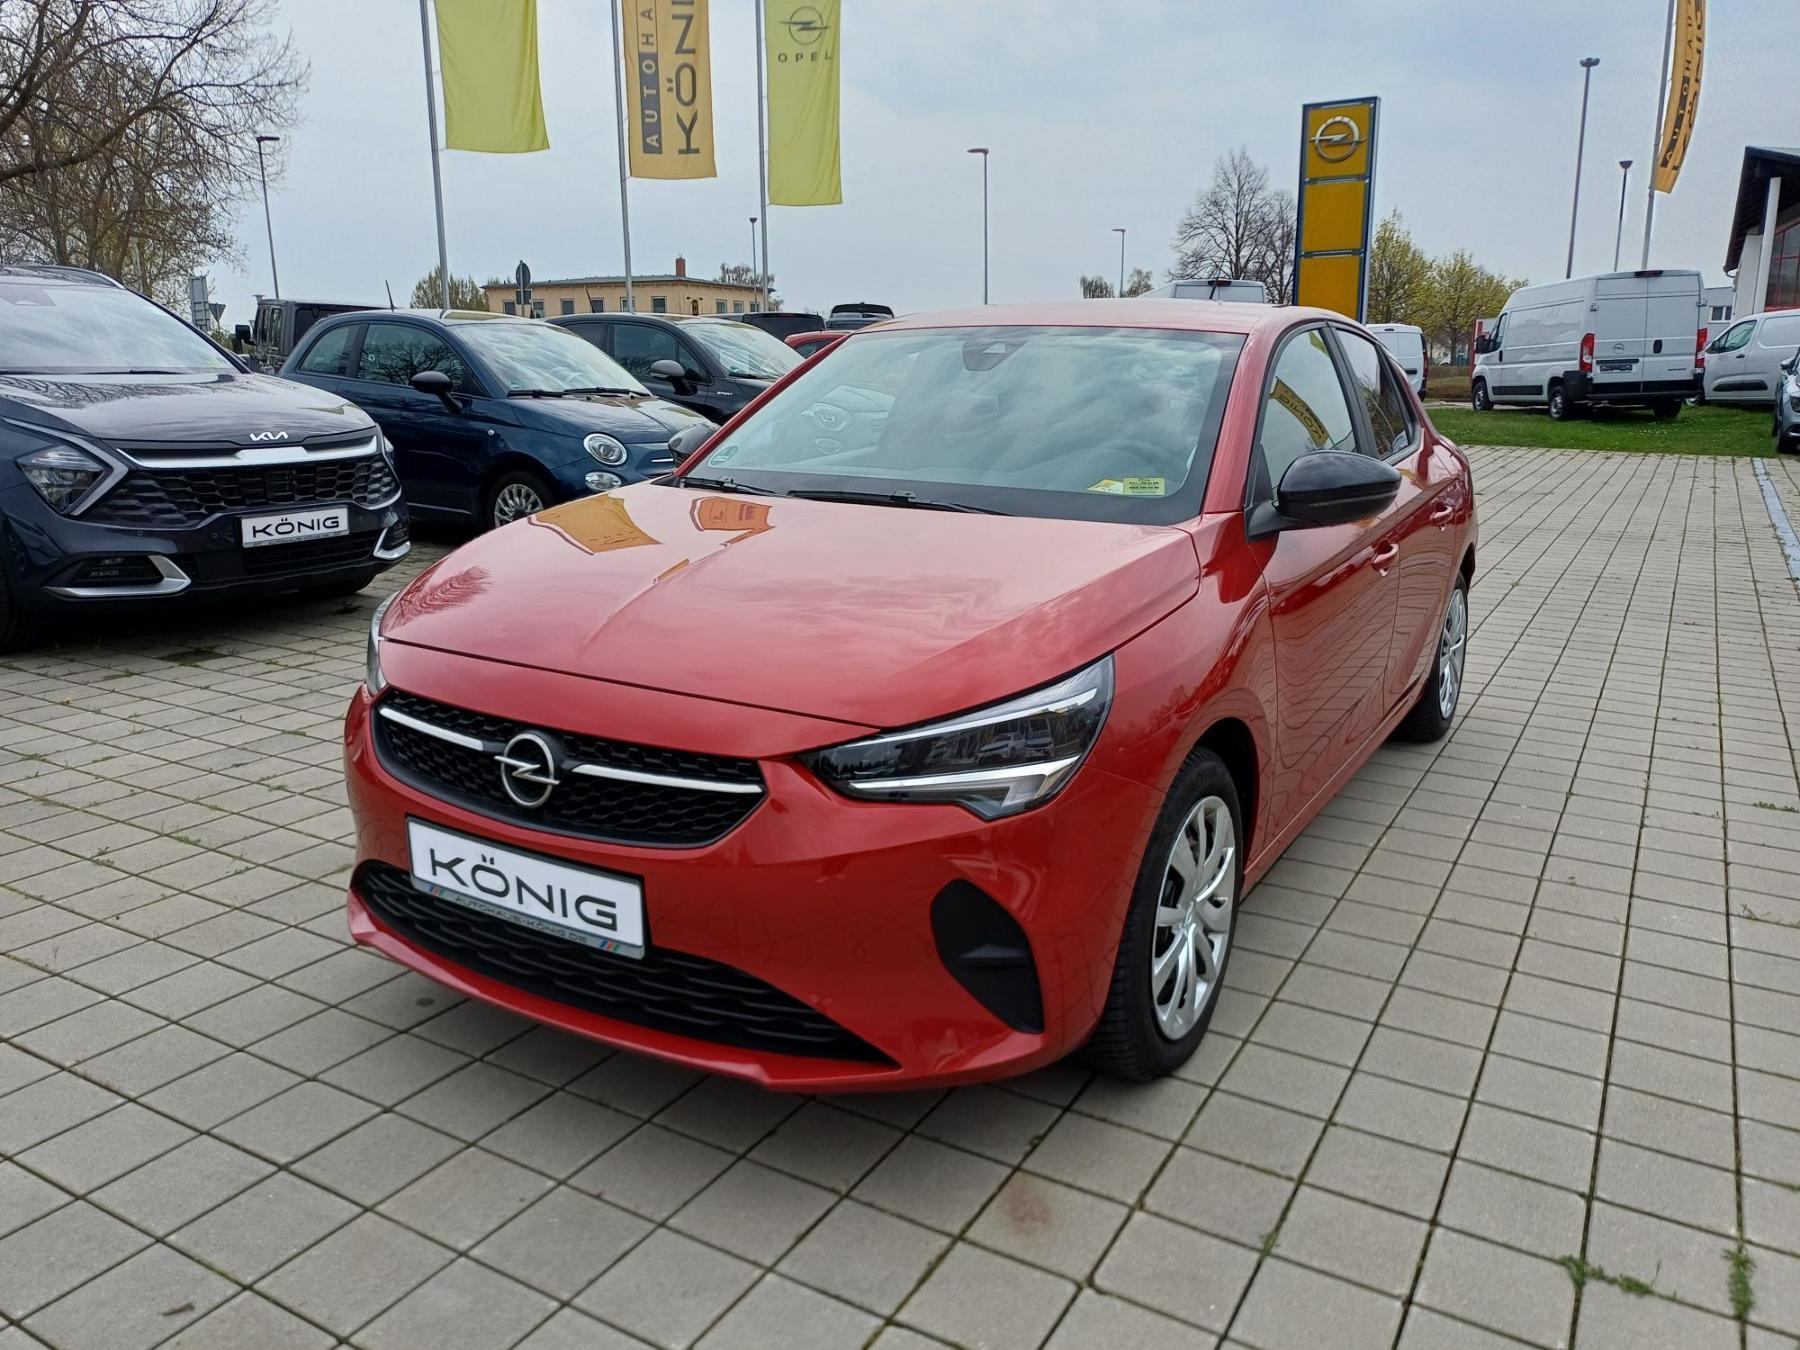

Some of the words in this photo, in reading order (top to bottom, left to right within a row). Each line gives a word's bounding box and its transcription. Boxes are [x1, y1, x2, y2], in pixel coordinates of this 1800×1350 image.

[777, 50, 832, 63] OPEL
[251, 516, 340, 539] KÖNIG
[429, 848, 618, 932] KÖNIG
